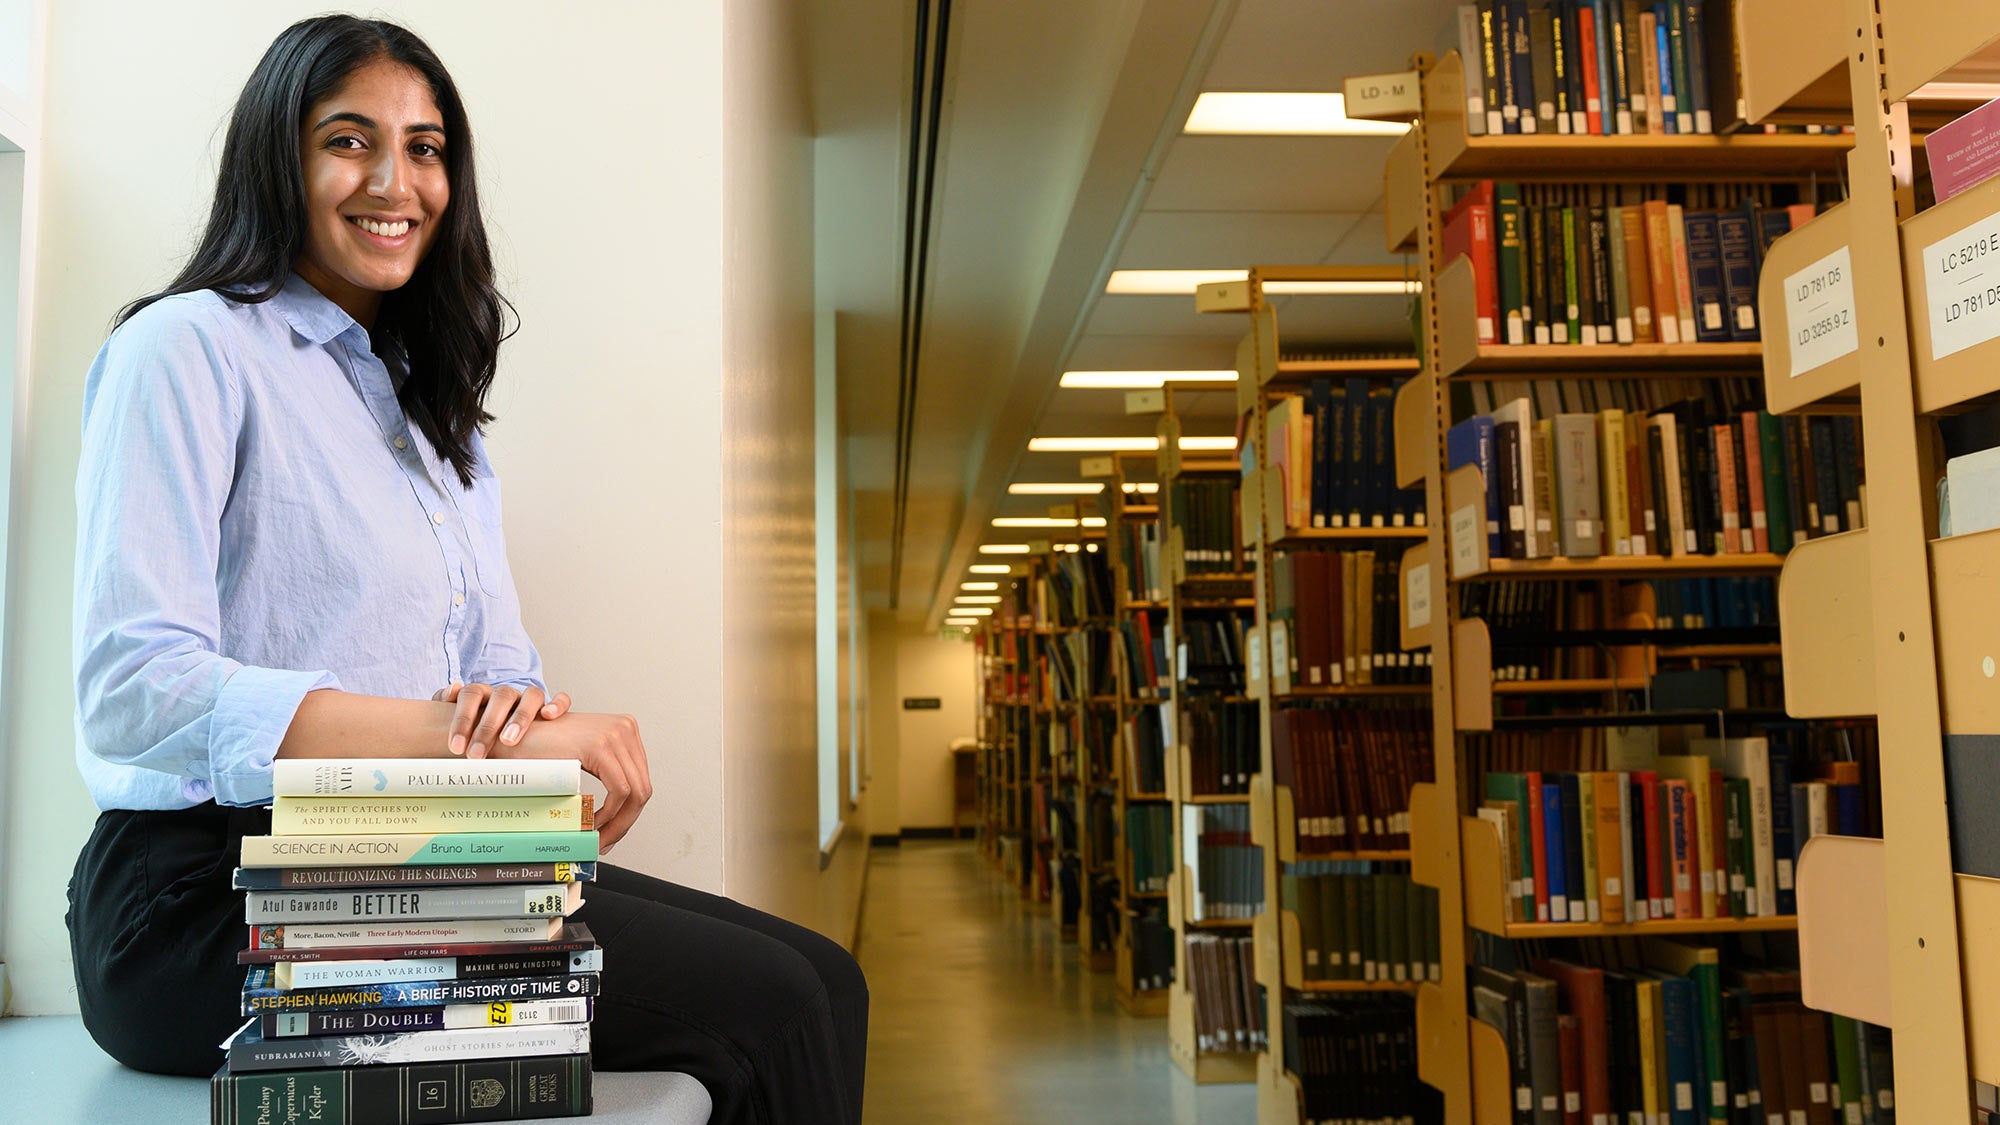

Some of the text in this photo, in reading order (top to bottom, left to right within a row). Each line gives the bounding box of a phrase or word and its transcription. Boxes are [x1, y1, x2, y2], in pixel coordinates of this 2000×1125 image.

[1360, 86, 1380, 99] LD
[1392, 85, 1405, 96] M
[1942, 233, 1999, 273] LC 5219 E
[1797, 267, 1841, 302] LD 781 D5
[1945, 303, 1961, 323] LD
[1963, 294, 1984, 316] 781
[1798, 310, 1849, 346] LD 3255.9 Z
[340, 766, 352, 793] AIR
[408, 774, 526, 786] PAUL KALANITHI
[312, 805, 348, 813] SPIRIT
[352, 805, 401, 813] CATCHES
[405, 805, 427, 813] YOU
[440, 810, 530, 819] ANNE FADIMAN
[328, 817, 351, 825] YOU
[355, 817, 381, 825] FALL
[386, 817, 418, 825] DOWN
[272, 842, 399, 854] SCIENCE IN ACTION
[431, 842, 571, 854] Bruno Latour HARVARD
[292, 867, 477, 884] REVOLUTIONIZING THE SCIENCES
[496, 867, 543, 879] Peter Dear
[262, 898, 338, 912] Atul Gawande
[352, 893, 420, 915] BETTER
[529, 902, 536, 912] RC
[294, 932, 313, 940] More,
[367, 928, 458, 938] Three Early Modern Utopias
[269, 953, 290, 961] TRACY
[304, 966, 444, 980] THE WOMAN WARRIOR
[465, 960, 561, 972] MAXINE HONG KINGSTON
[397, 981, 561, 1002] A BRIEF HISTORY OF TIME
[251, 991, 383, 1010] STEPHEN HAWKING
[491, 1001, 507, 1024] ED
[518, 1011, 538, 1020] 3113
[318, 1014, 355, 1030] THE
[363, 1013, 433, 1028] DOUBLE
[424, 1044, 457, 1052] GHOST
[461, 1042, 501, 1050] STORIES
[518, 1039, 556, 1048] DARWIN
[255, 1050, 331, 1061] SUBRAMANIAM
[426, 1087, 439, 1101] 16
[539, 1075, 548, 1102] GREAT
[549, 1073, 557, 1102] BOOKS
[257, 1086, 275, 1125] Ptolemy
[308, 1085, 327, 1120] Kepler
